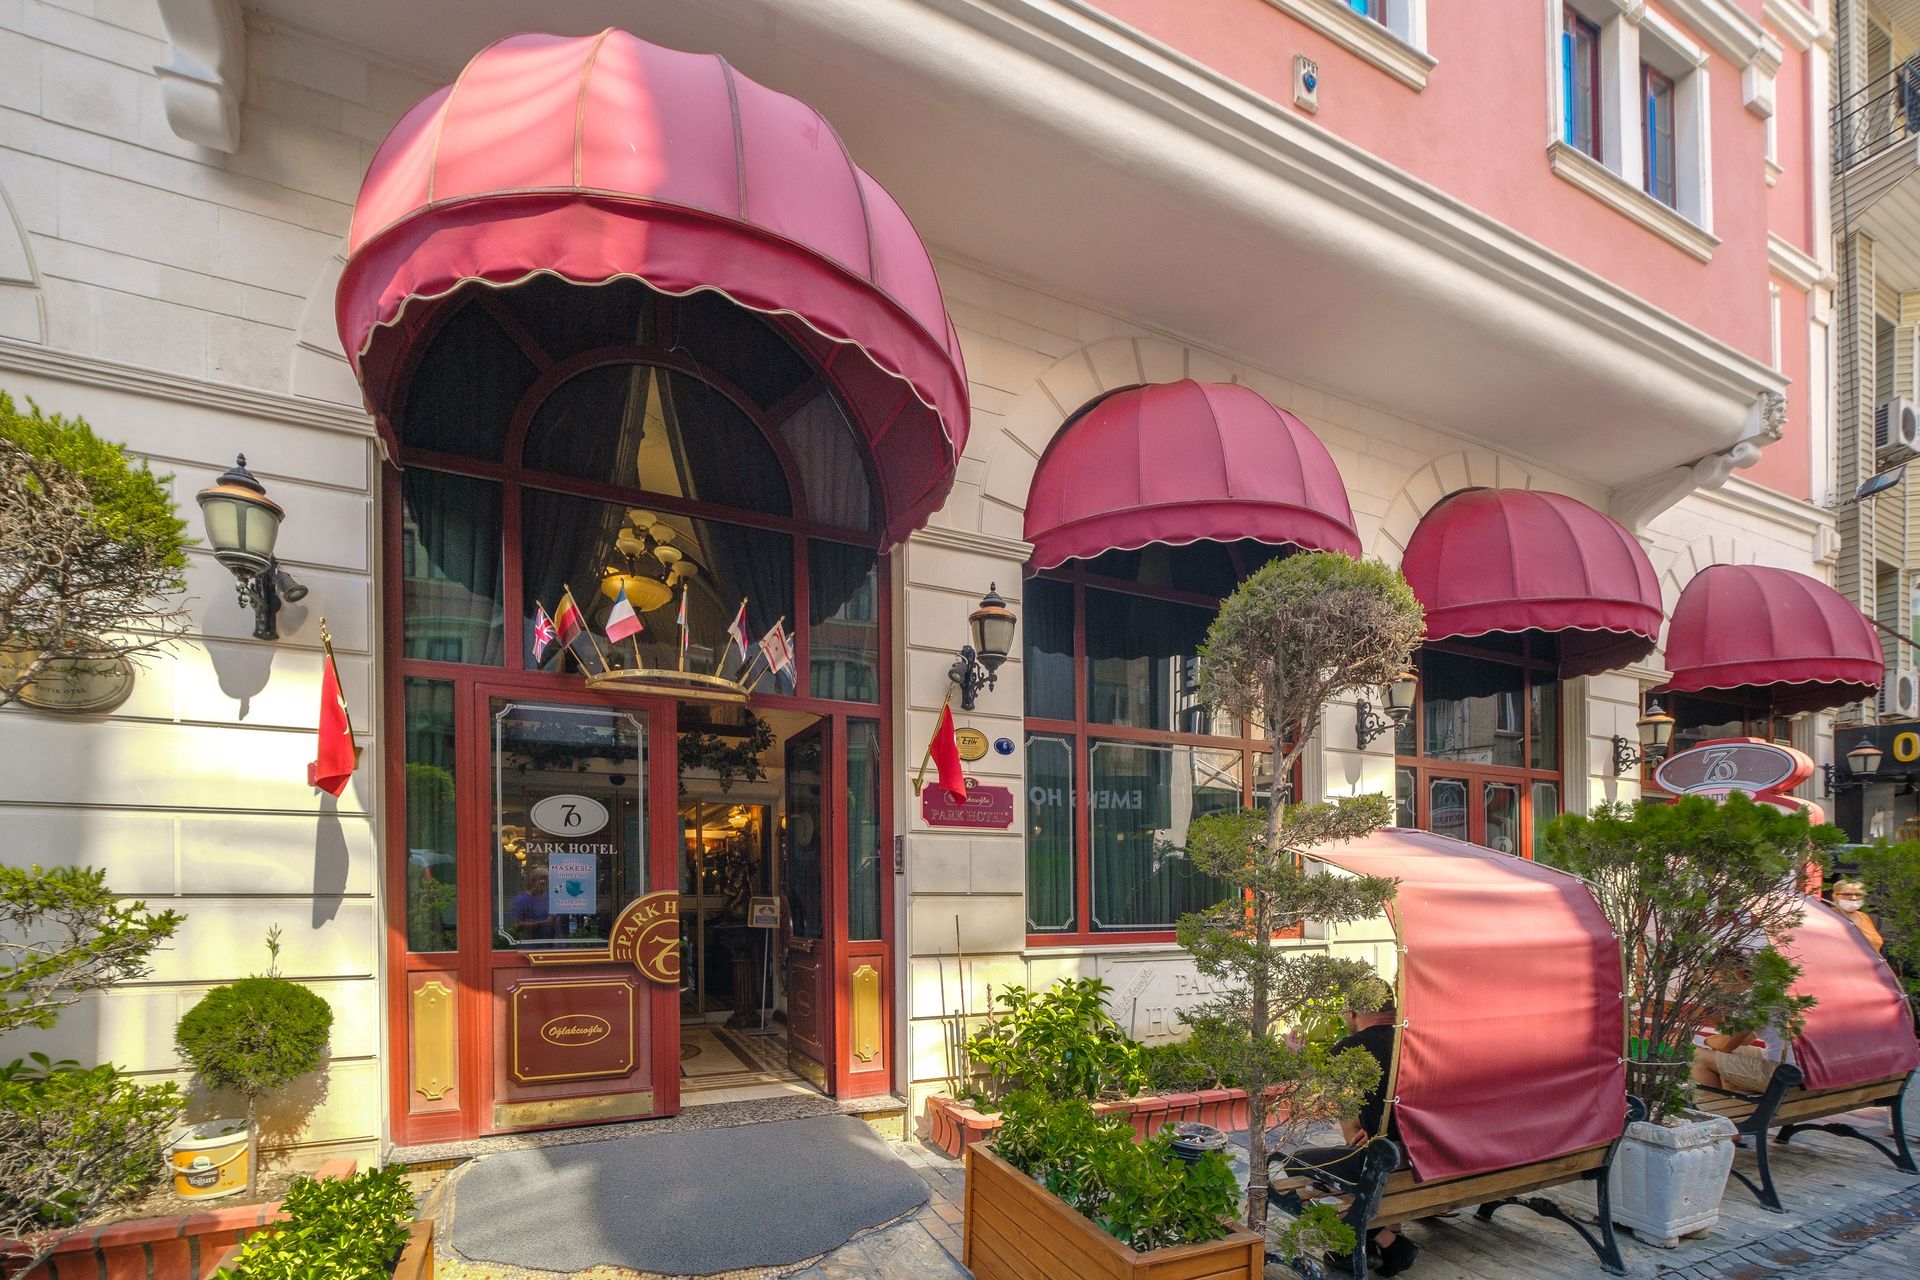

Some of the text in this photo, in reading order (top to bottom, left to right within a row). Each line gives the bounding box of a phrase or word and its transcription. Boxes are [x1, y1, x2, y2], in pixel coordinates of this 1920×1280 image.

[1703, 748, 1738, 784] 76
[561, 804, 582, 828] 76
[931, 809, 965, 821] PARK
[526, 842, 618, 855] PARK HOTEL
[617, 902, 661, 947] PARK
